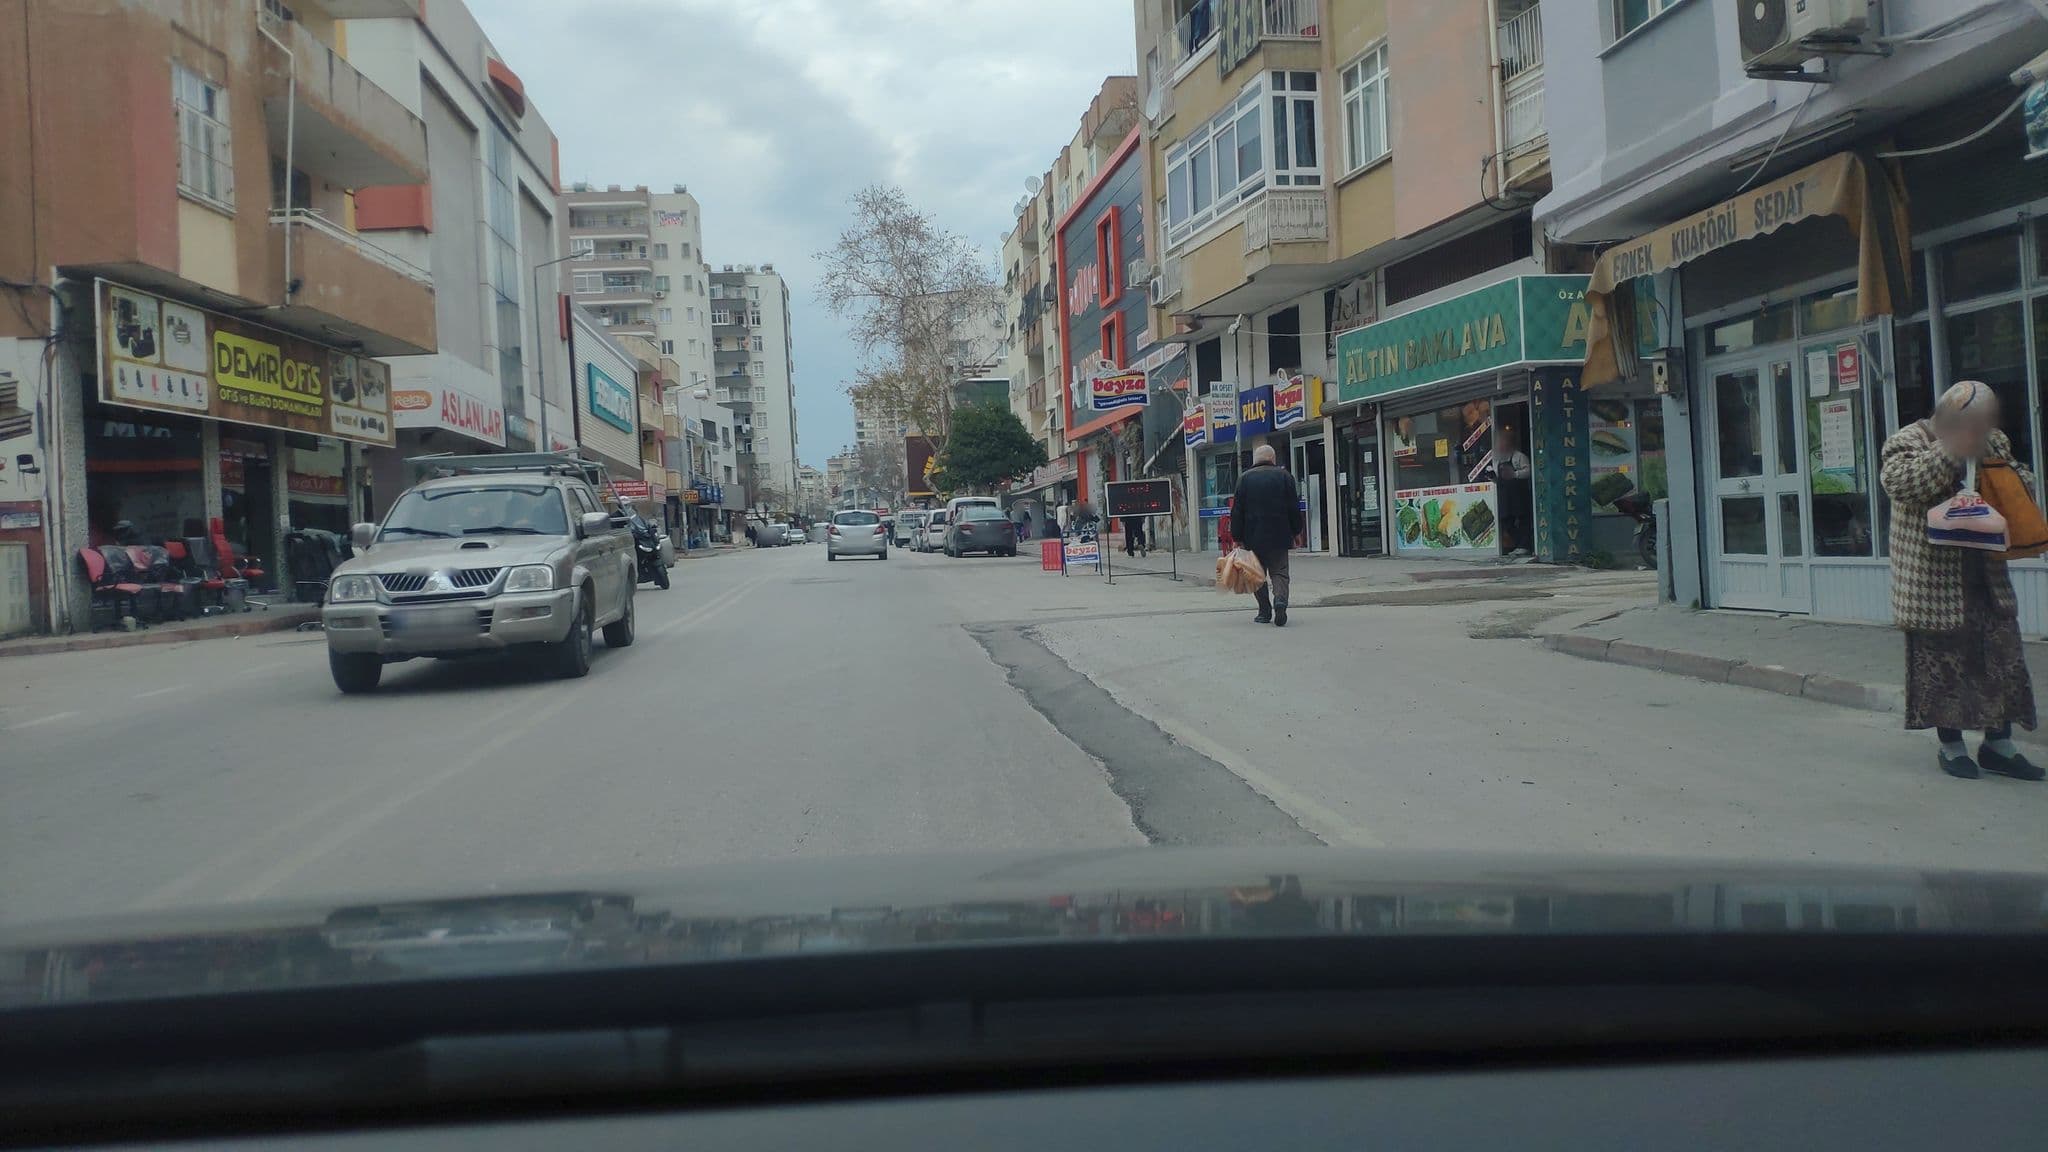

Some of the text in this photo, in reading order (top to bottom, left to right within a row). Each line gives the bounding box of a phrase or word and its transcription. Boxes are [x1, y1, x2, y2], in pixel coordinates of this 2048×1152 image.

[1613, 181, 1806, 282] ERKEK KUAFÖRÜ SEDAT
[1346, 344, 1399, 385] ALTIN
[1405, 312, 1507, 370] BAKLAVA
[1092, 377, 1146, 394] beyza
[1243, 397, 1266, 423] PİLİÇ
[442, 389, 501, 439] ASLANLAR
[1561, 378, 1580, 555] ALTIN BAKLAVA
[1066, 546, 1098, 555] beyza
